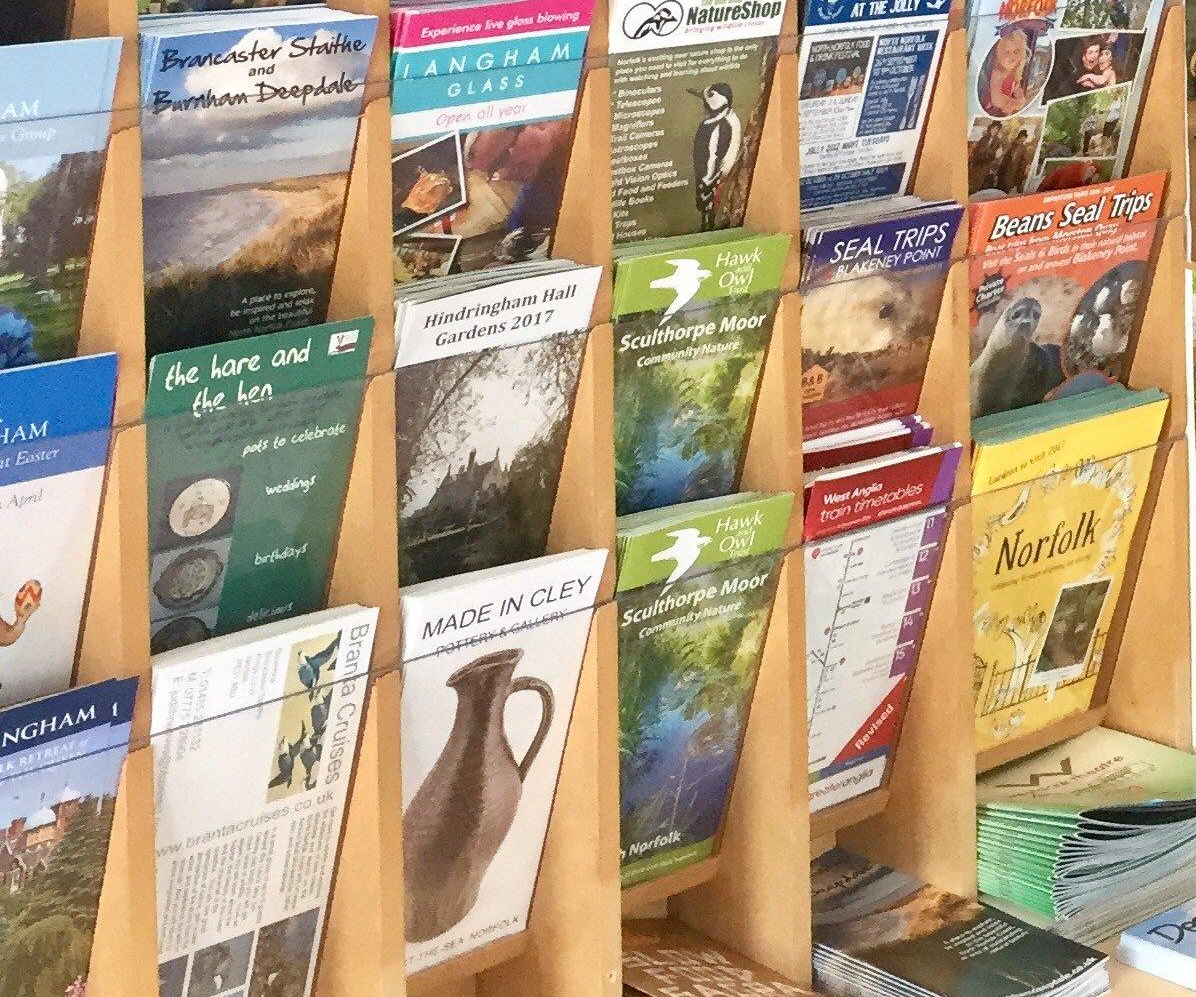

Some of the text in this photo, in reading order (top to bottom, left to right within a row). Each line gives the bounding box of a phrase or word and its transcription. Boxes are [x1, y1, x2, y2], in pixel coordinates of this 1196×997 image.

[421, 11, 581, 38] Experience live glass blowing
[686, 0, 782, 25] NatureShop
[850, 2, 868, 18] AT
[869, 0, 887, 15] THE
[159, 33, 366, 73] Brancaster Staithe
[403, 43, 571, 81] LANGHAM
[248, 64, 275, 77] and
[447, 74, 525, 98] GLASS
[152, 72, 358, 116] Burnham Deepdale
[618, 86, 662, 98] Binoculars
[436, 104, 528, 128] Open all year
[987, 209, 1055, 243] Beans
[1057, 195, 1107, 229] Seal
[1108, 189, 1154, 222] Trips
[715, 247, 763, 268] Hawk
[830, 222, 950, 265] SEAL TRIPS
[718, 268, 754, 289] Owl
[835, 246, 943, 279] BLAKENEY POINT
[423, 284, 578, 330] Hindringham Hall
[435, 309, 555, 348] Gardens 2017
[618, 313, 767, 353] Sculthorpe Moor
[165, 337, 312, 391] the hare and
[636, 340, 739, 368] Community Nature
[192, 380, 274, 418] the hen
[241, 422, 347, 458] pots to celebrate
[15, 449, 60, 466] Easter
[265, 474, 318, 497] weddings
[820, 505, 852, 523] train
[854, 481, 924, 513] timetables
[823, 481, 884, 506] West Anglia
[715, 510, 764, 534] Hawk
[719, 531, 755, 553] Owl
[994, 510, 1102, 576] Norfolk
[422, 575, 592, 640] MADE IN CLEY
[620, 573, 770, 627] Sculthorpe Moor
[324, 622, 371, 785] Branta Cruises
[854, 703, 895, 750] Revised
[629, 830, 682, 857] Norfolk
